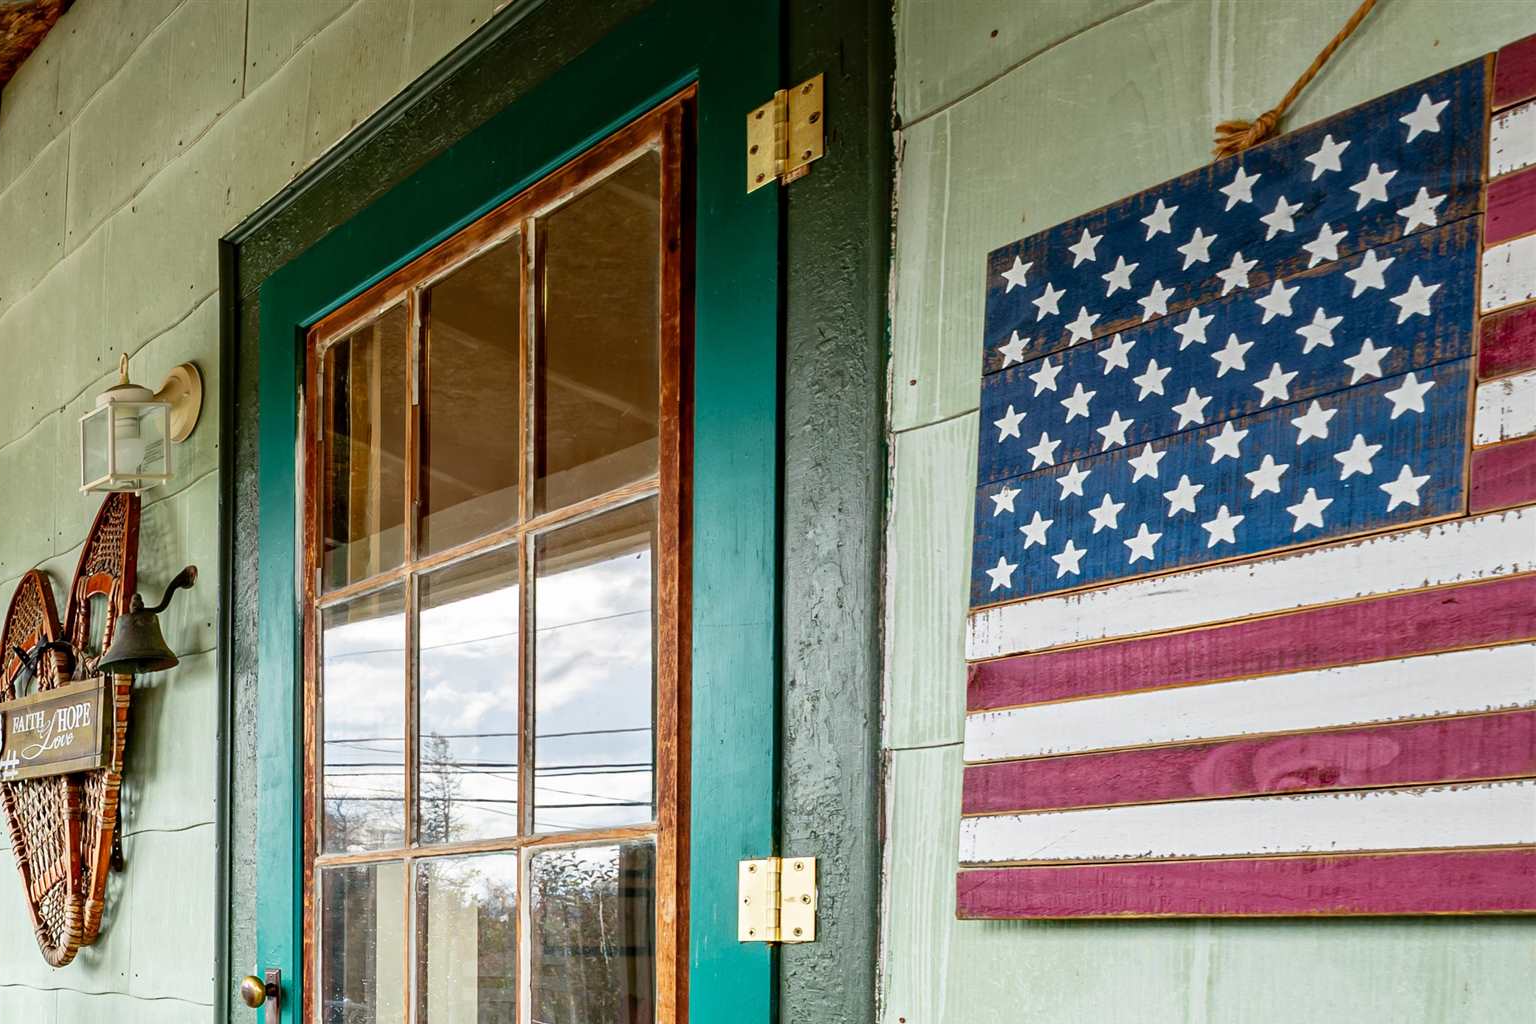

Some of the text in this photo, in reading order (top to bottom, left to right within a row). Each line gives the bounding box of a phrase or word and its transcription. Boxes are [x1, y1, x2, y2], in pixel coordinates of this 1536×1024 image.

[13, 702, 91, 734] FAITH HOPE
[21, 711, 74, 760] Love
